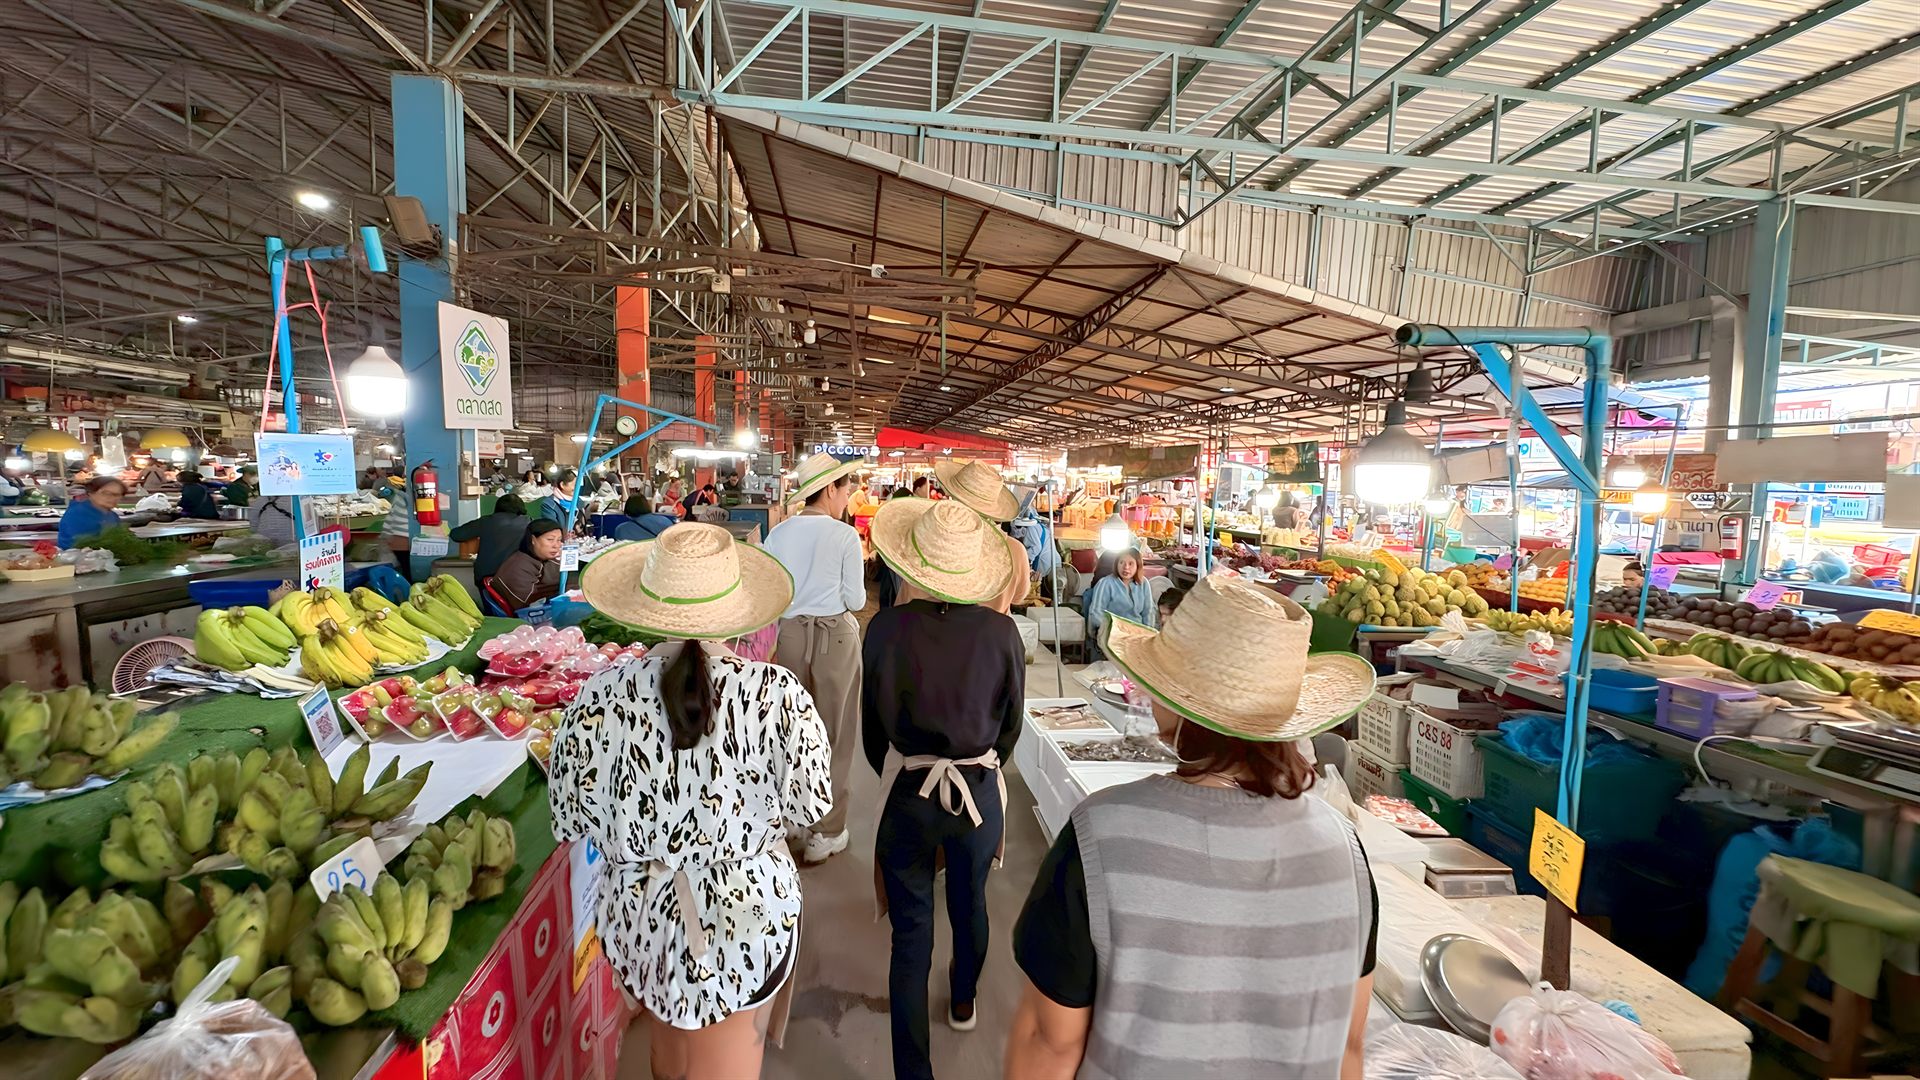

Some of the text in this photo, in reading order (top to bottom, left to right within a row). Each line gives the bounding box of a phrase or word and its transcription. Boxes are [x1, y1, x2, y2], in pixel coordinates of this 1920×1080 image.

[456, 398, 503, 416] ตลาดสด
[1417, 721, 1452, 750] C&S 88
[328, 858, 367, 892] 25
